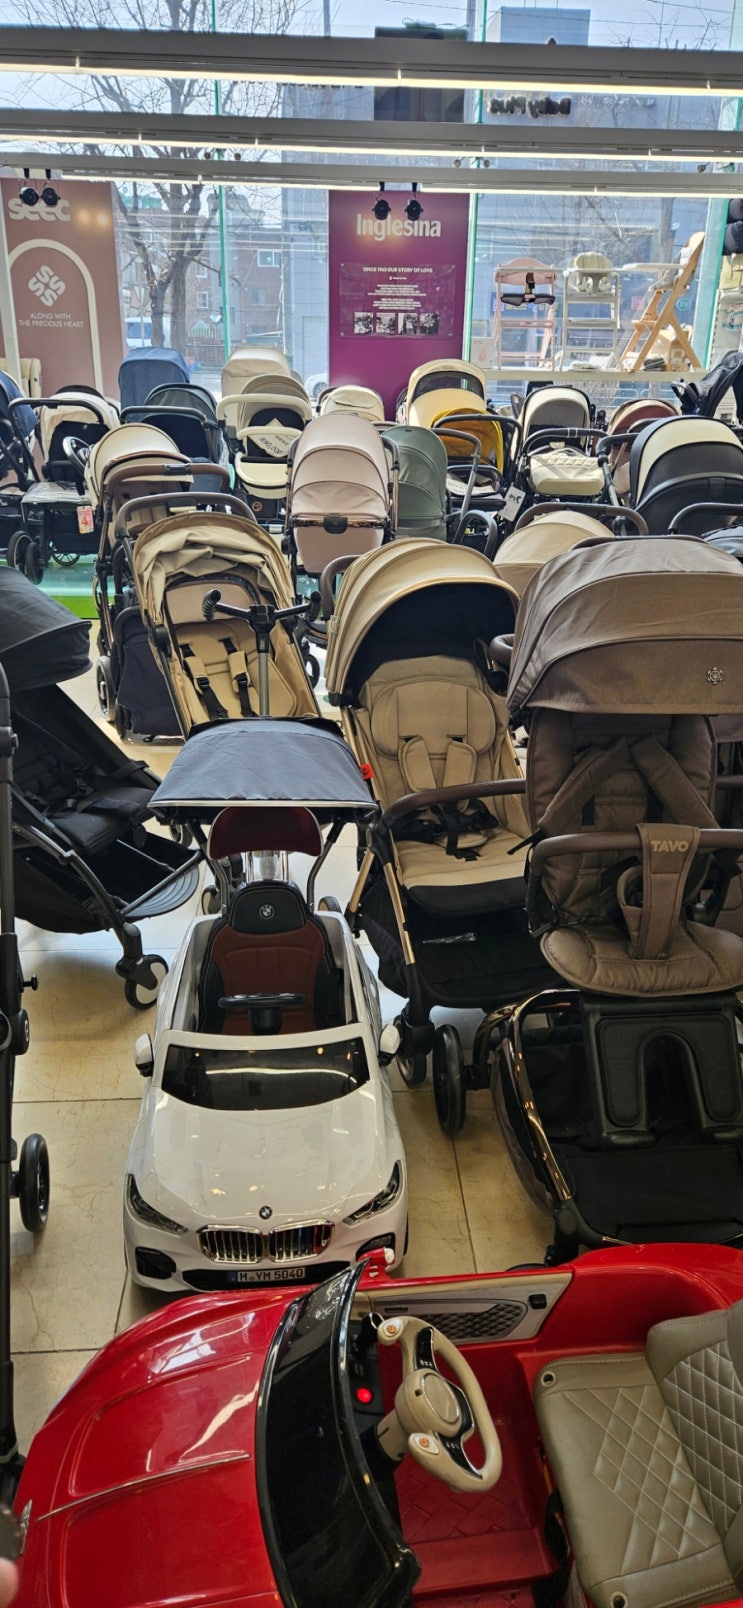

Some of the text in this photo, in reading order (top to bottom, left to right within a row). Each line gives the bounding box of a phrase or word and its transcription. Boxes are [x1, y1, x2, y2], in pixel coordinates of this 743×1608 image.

[356, 213, 442, 241] Inglesina
[30, 312, 53, 320] ALONG
[32, 320, 63, 328] PRECIOUS
[64, 321, 84, 329] HEART
[650, 840, 689, 852] TAVO
[274, 1268, 304, 1280] 5040
